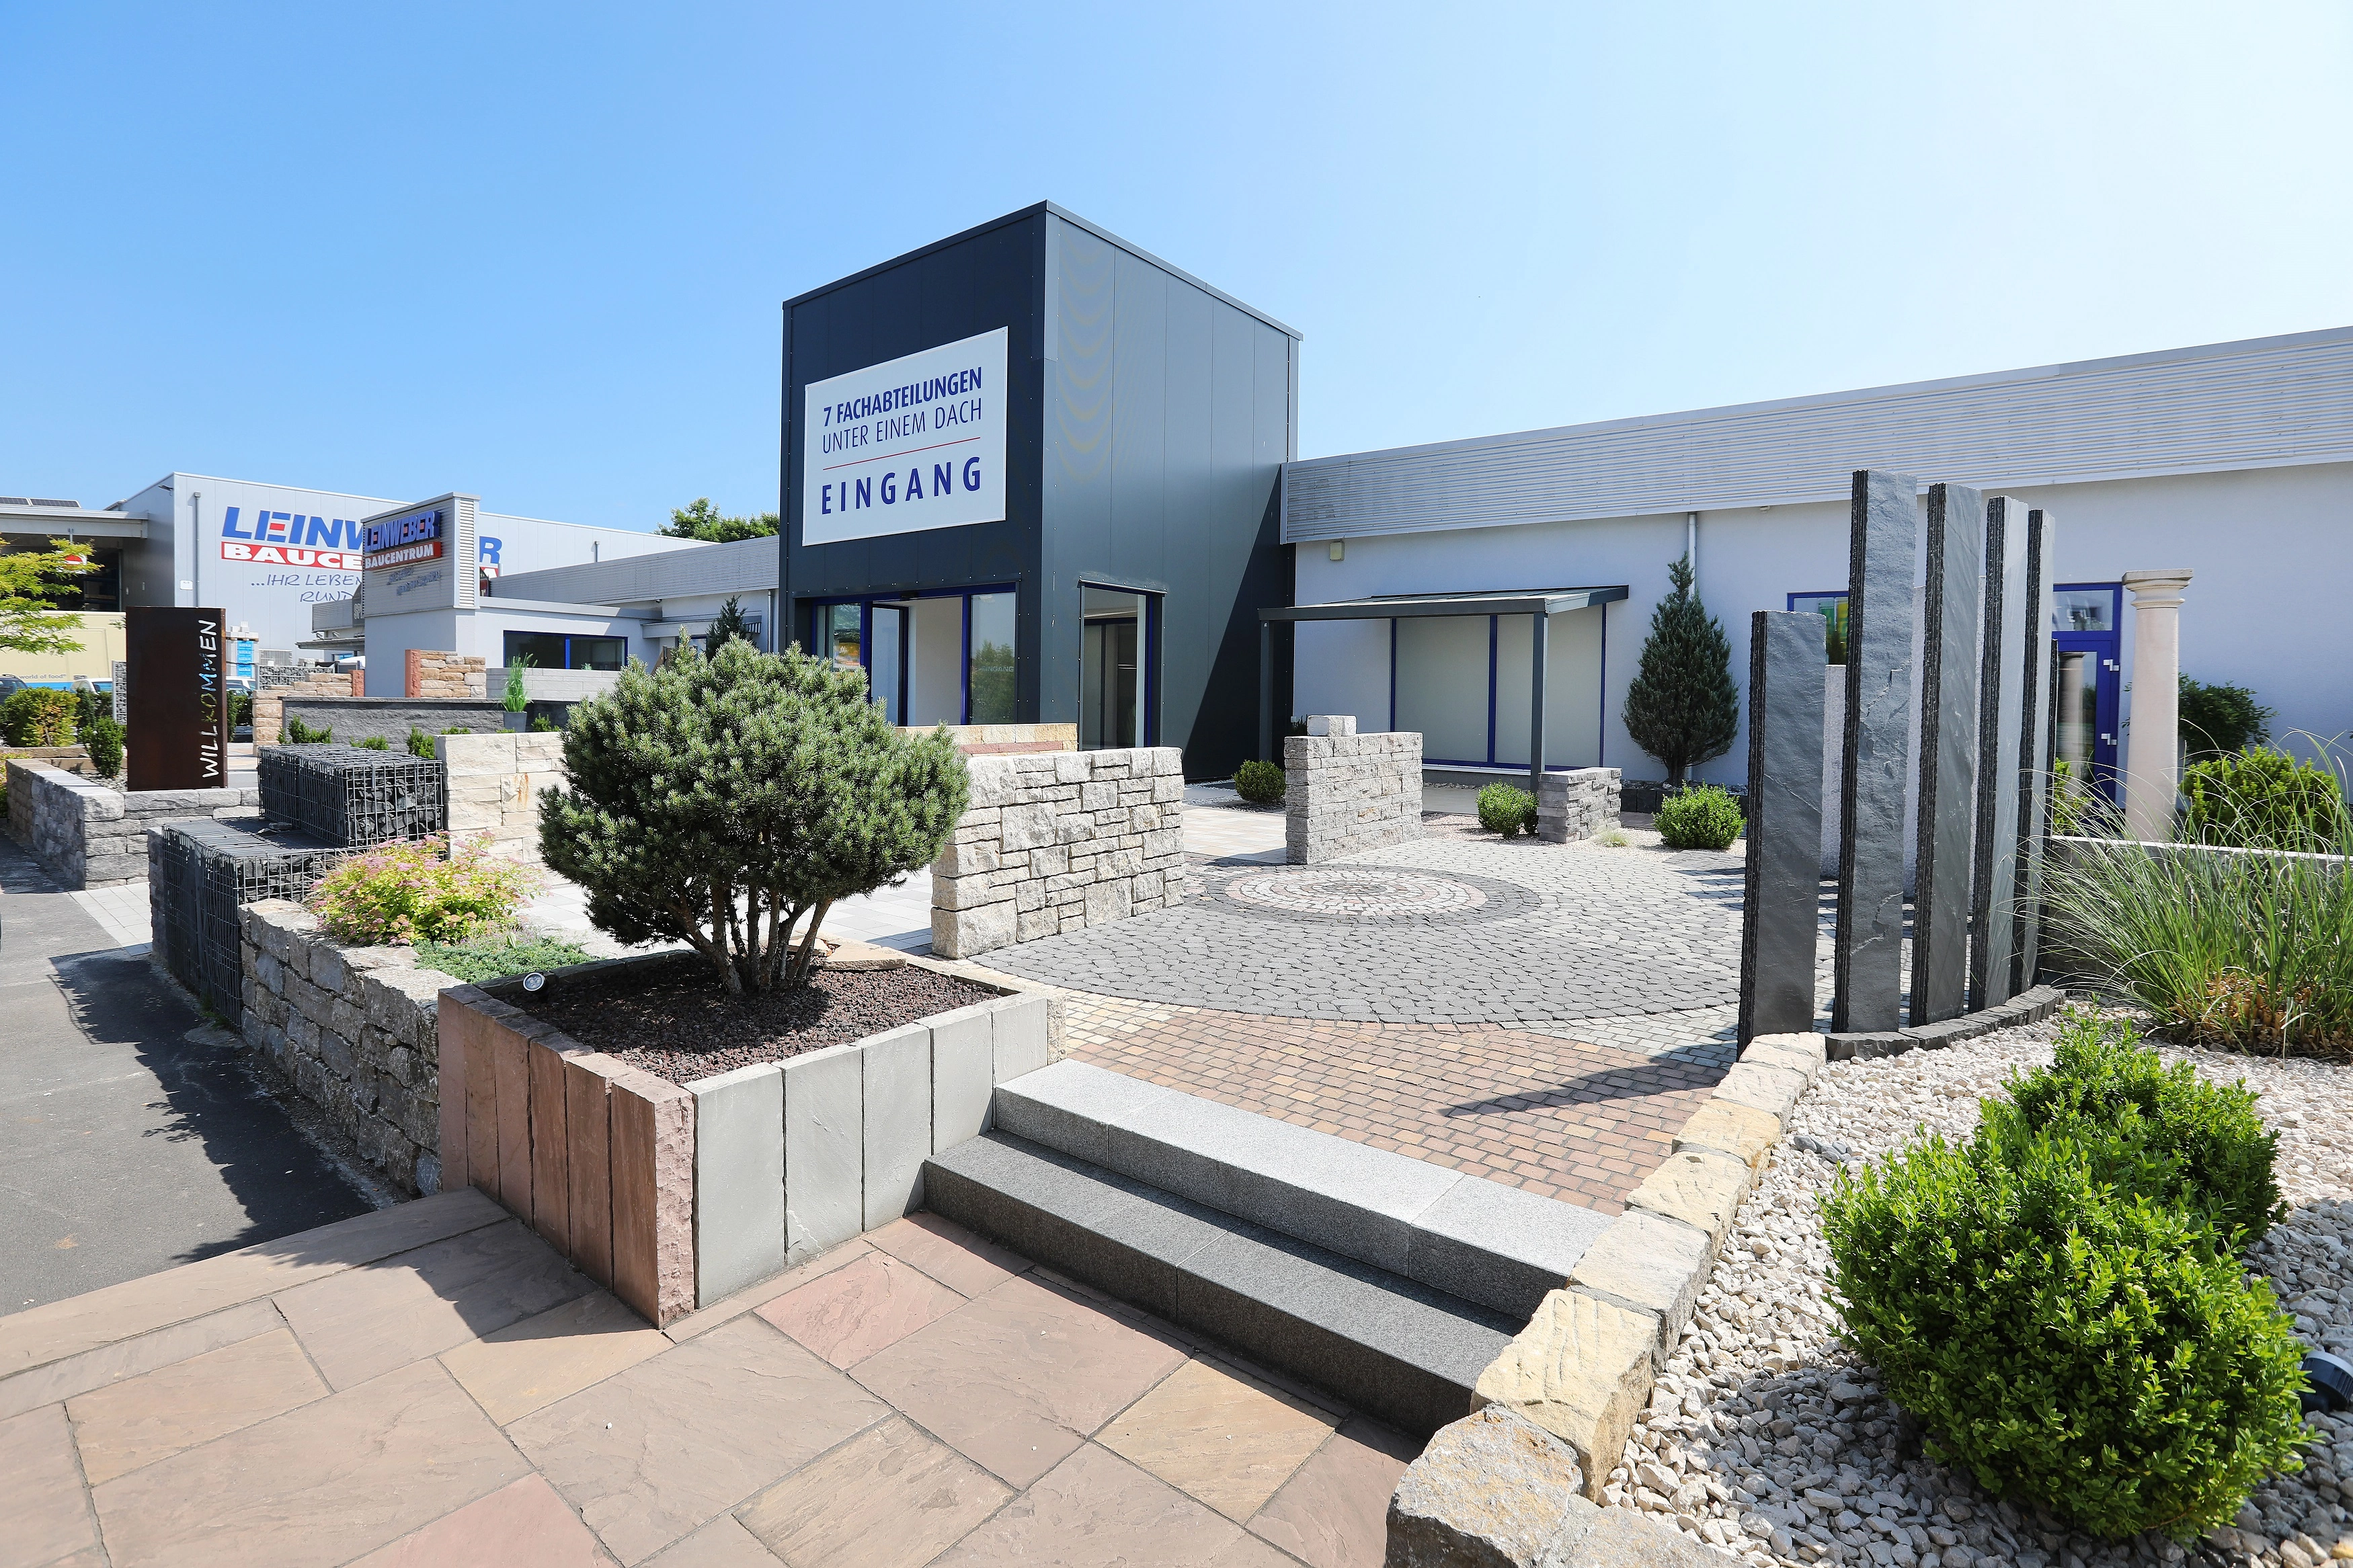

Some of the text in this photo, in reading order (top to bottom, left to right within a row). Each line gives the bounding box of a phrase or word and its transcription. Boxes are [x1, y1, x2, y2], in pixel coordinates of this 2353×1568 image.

[822, 397, 982, 454] UNTER EINEM DACH
[824, 366, 982, 427] 7 FACHABTEILUNGEN
[822, 456, 981, 515] EINGANG
[364, 511, 438, 552] LEINWEBER
[365, 543, 434, 569] BAUCENTRUM
[198, 620, 219, 778] WILLKOMMEN
